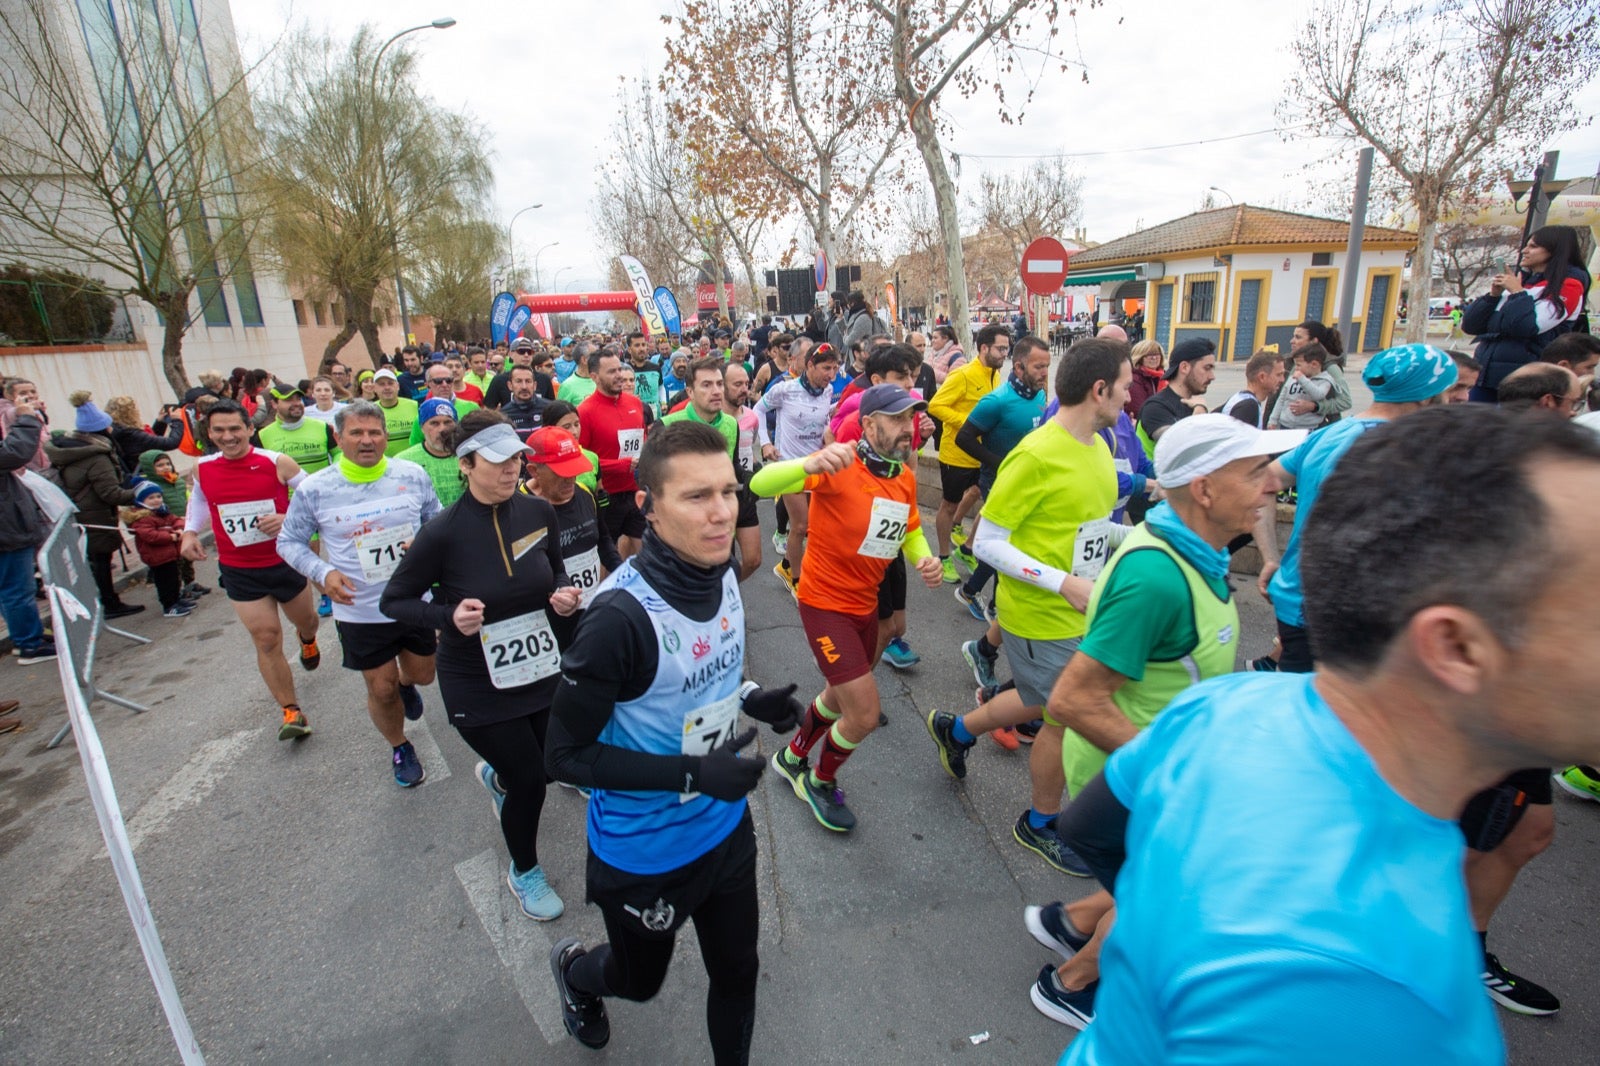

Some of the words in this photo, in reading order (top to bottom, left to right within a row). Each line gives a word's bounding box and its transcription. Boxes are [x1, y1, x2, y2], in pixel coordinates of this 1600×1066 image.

[624, 438, 640, 452] 518
[1083, 534, 1109, 561] 52
[490, 630, 554, 670] 2203
[816, 635, 841, 664] FILA
